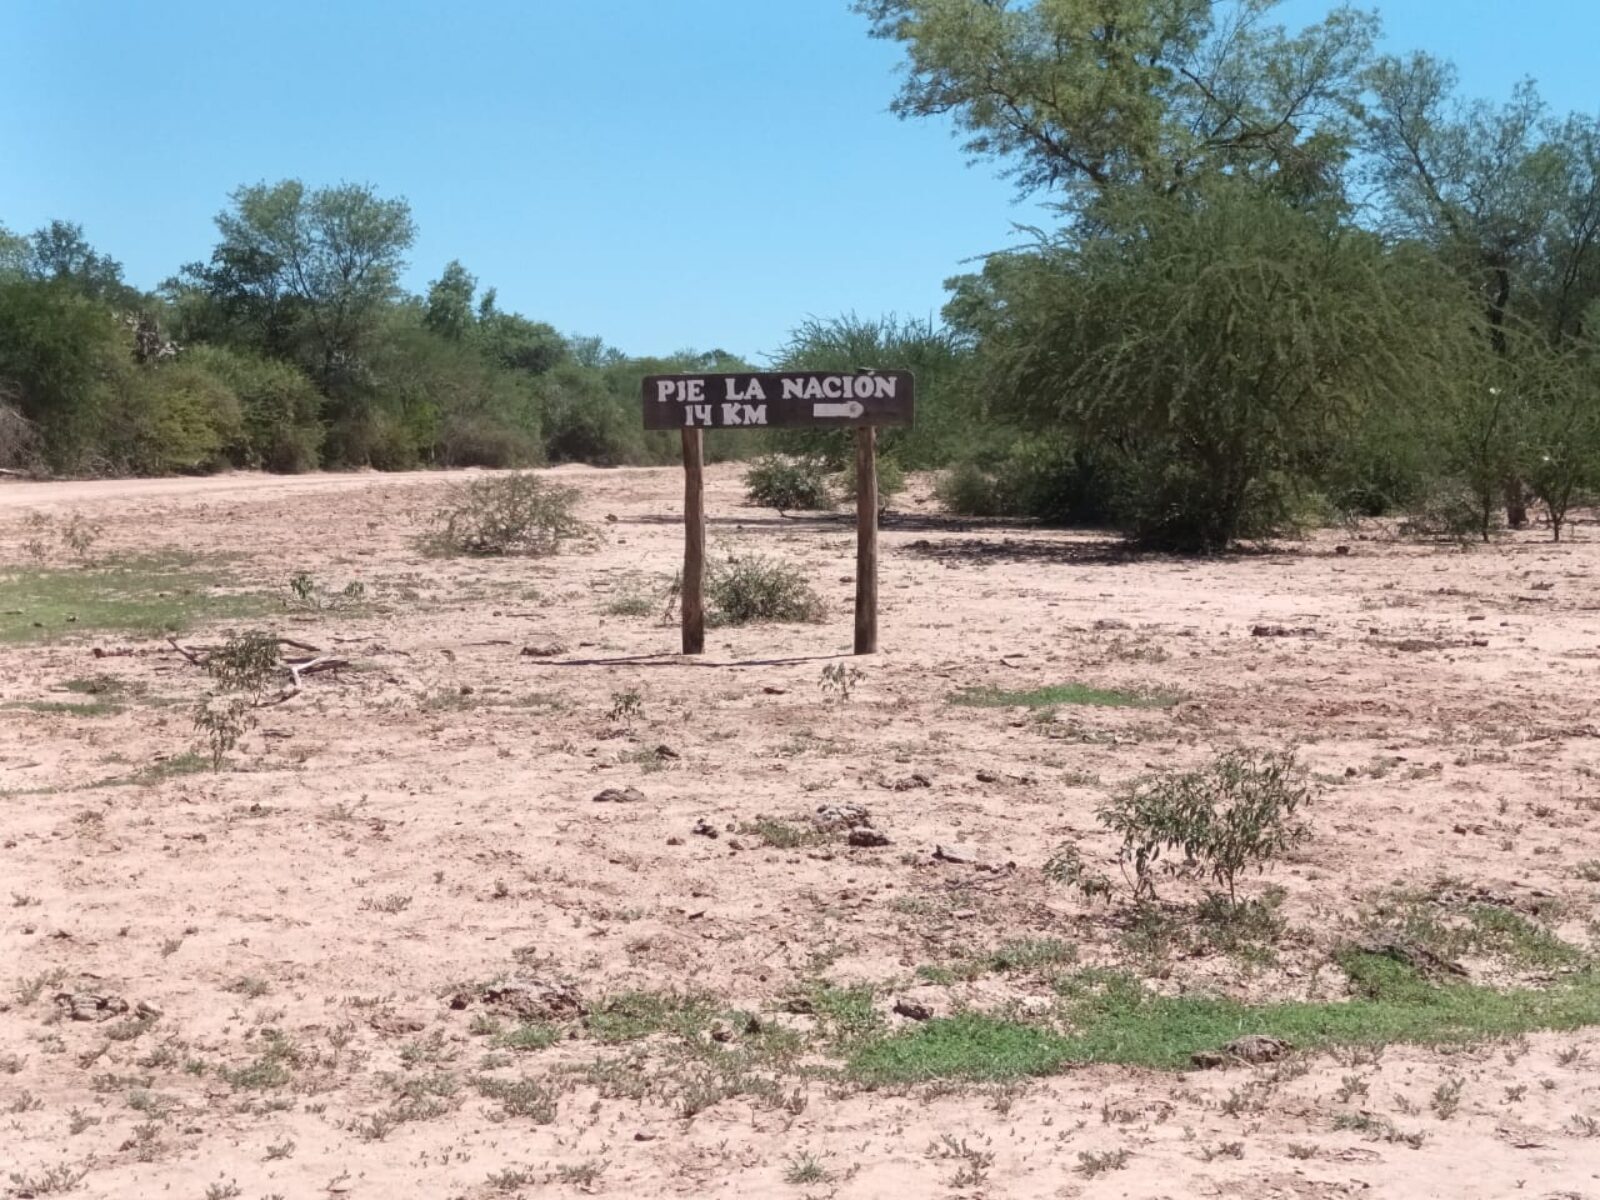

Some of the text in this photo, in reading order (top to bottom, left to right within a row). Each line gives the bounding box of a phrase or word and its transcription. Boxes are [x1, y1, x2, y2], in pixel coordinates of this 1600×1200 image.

[725, 378, 766, 400] LA
[781, 371, 897, 399] NACIÓN
[685, 402, 767, 426] 14 KM
